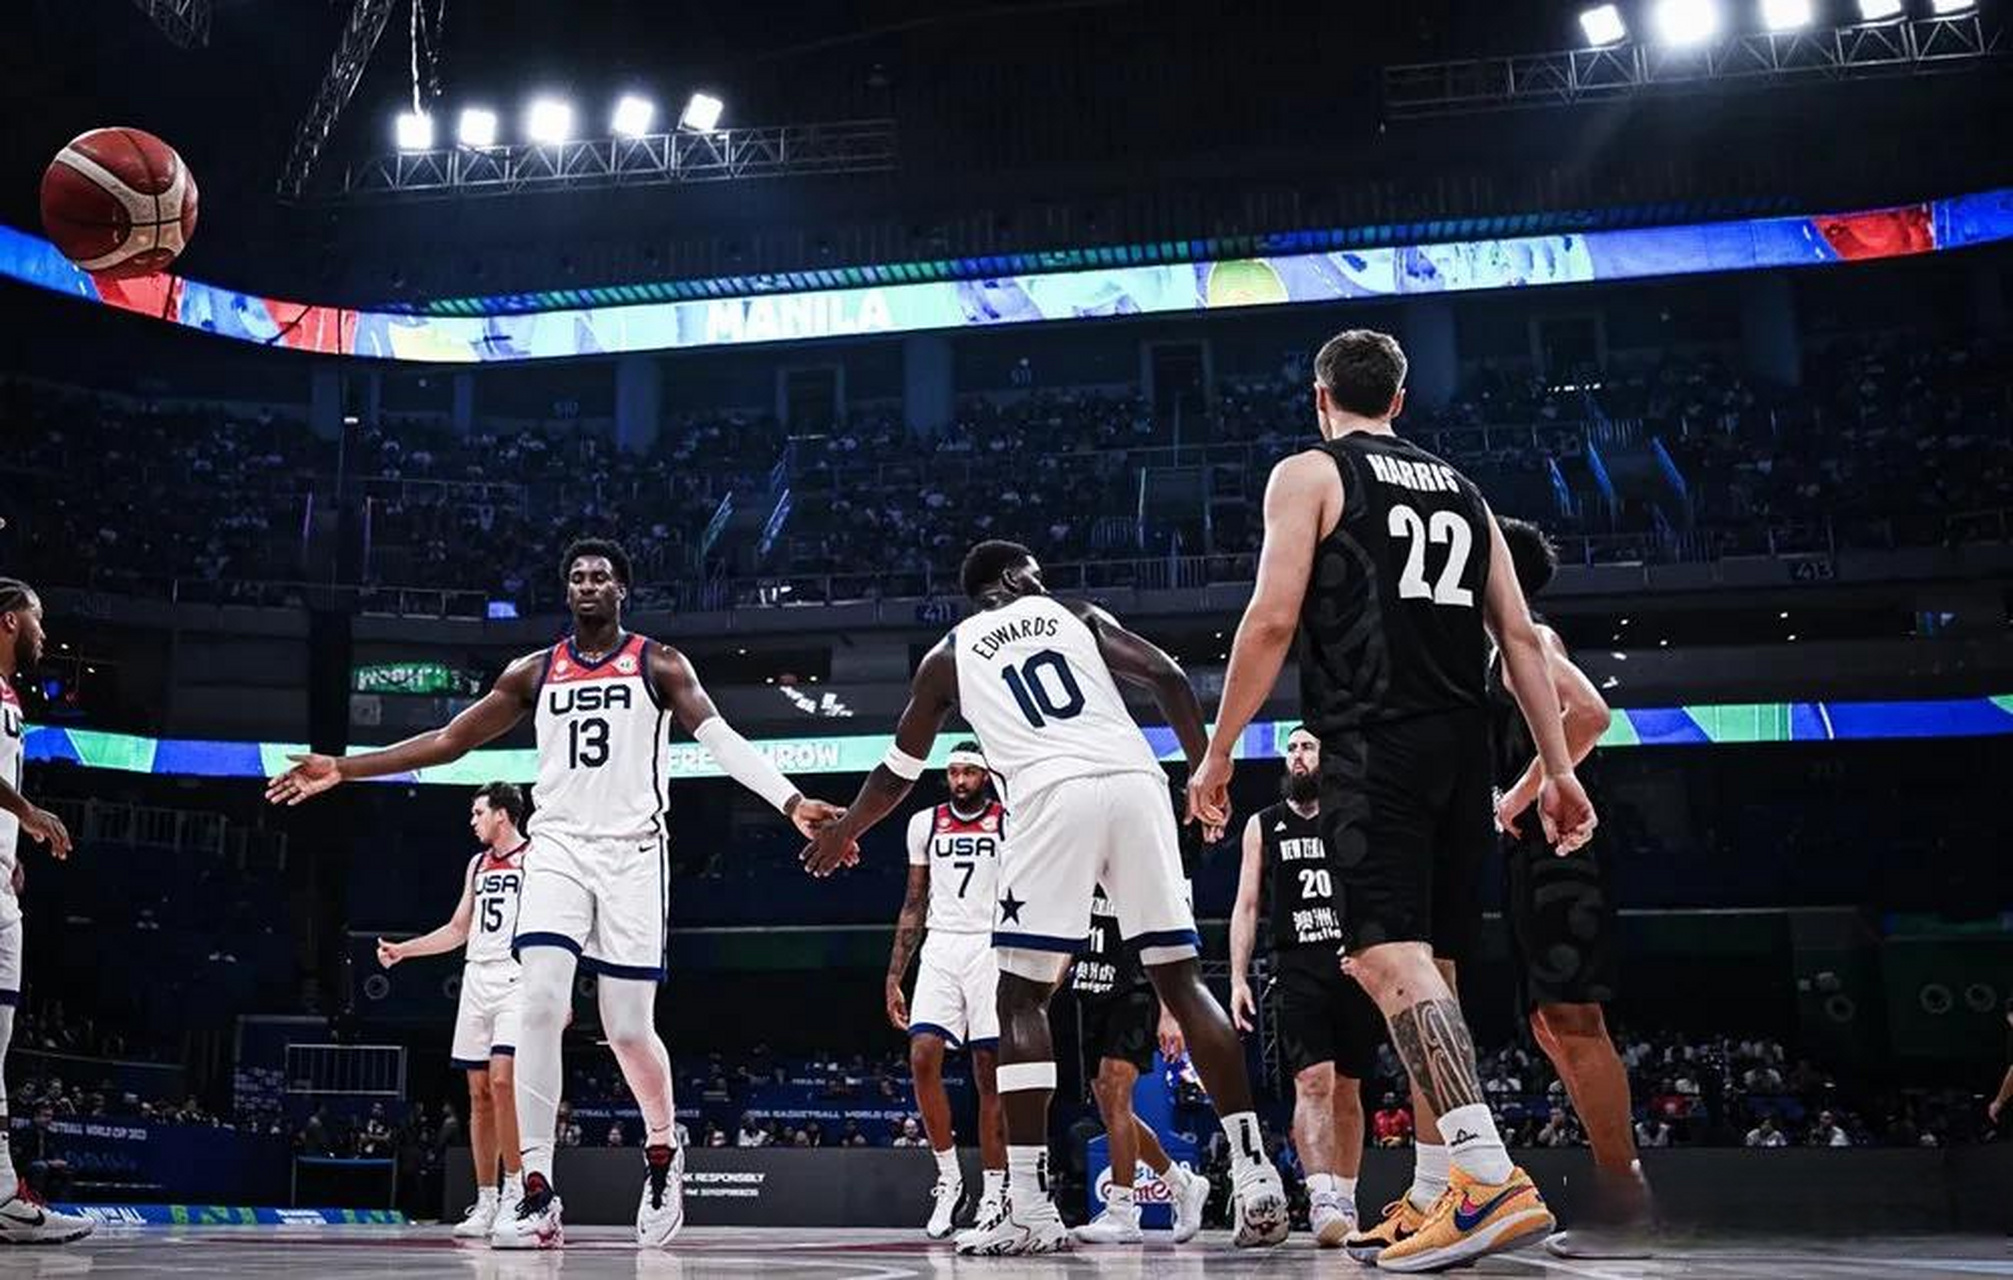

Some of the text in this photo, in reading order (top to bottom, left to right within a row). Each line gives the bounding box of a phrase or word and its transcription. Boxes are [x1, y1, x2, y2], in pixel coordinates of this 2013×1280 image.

[707, 291, 888, 341] MANILA
[1365, 453, 1460, 493] HARRIS
[1387, 503, 1474, 607] 22
[972, 617, 1059, 661] EDWARDS
[550, 684, 631, 715] USA
[1002, 649, 1085, 728] 10
[569, 718, 609, 769] 13
[936, 837, 995, 858] USA
[474, 875, 518, 895] USA
[954, 862, 975, 898] 7
[1298, 868, 1333, 900] 20
[481, 898, 504, 933] 15
[772, 1109, 840, 1120] BASKETBALL
[844, 1109, 882, 1119] WORLD
